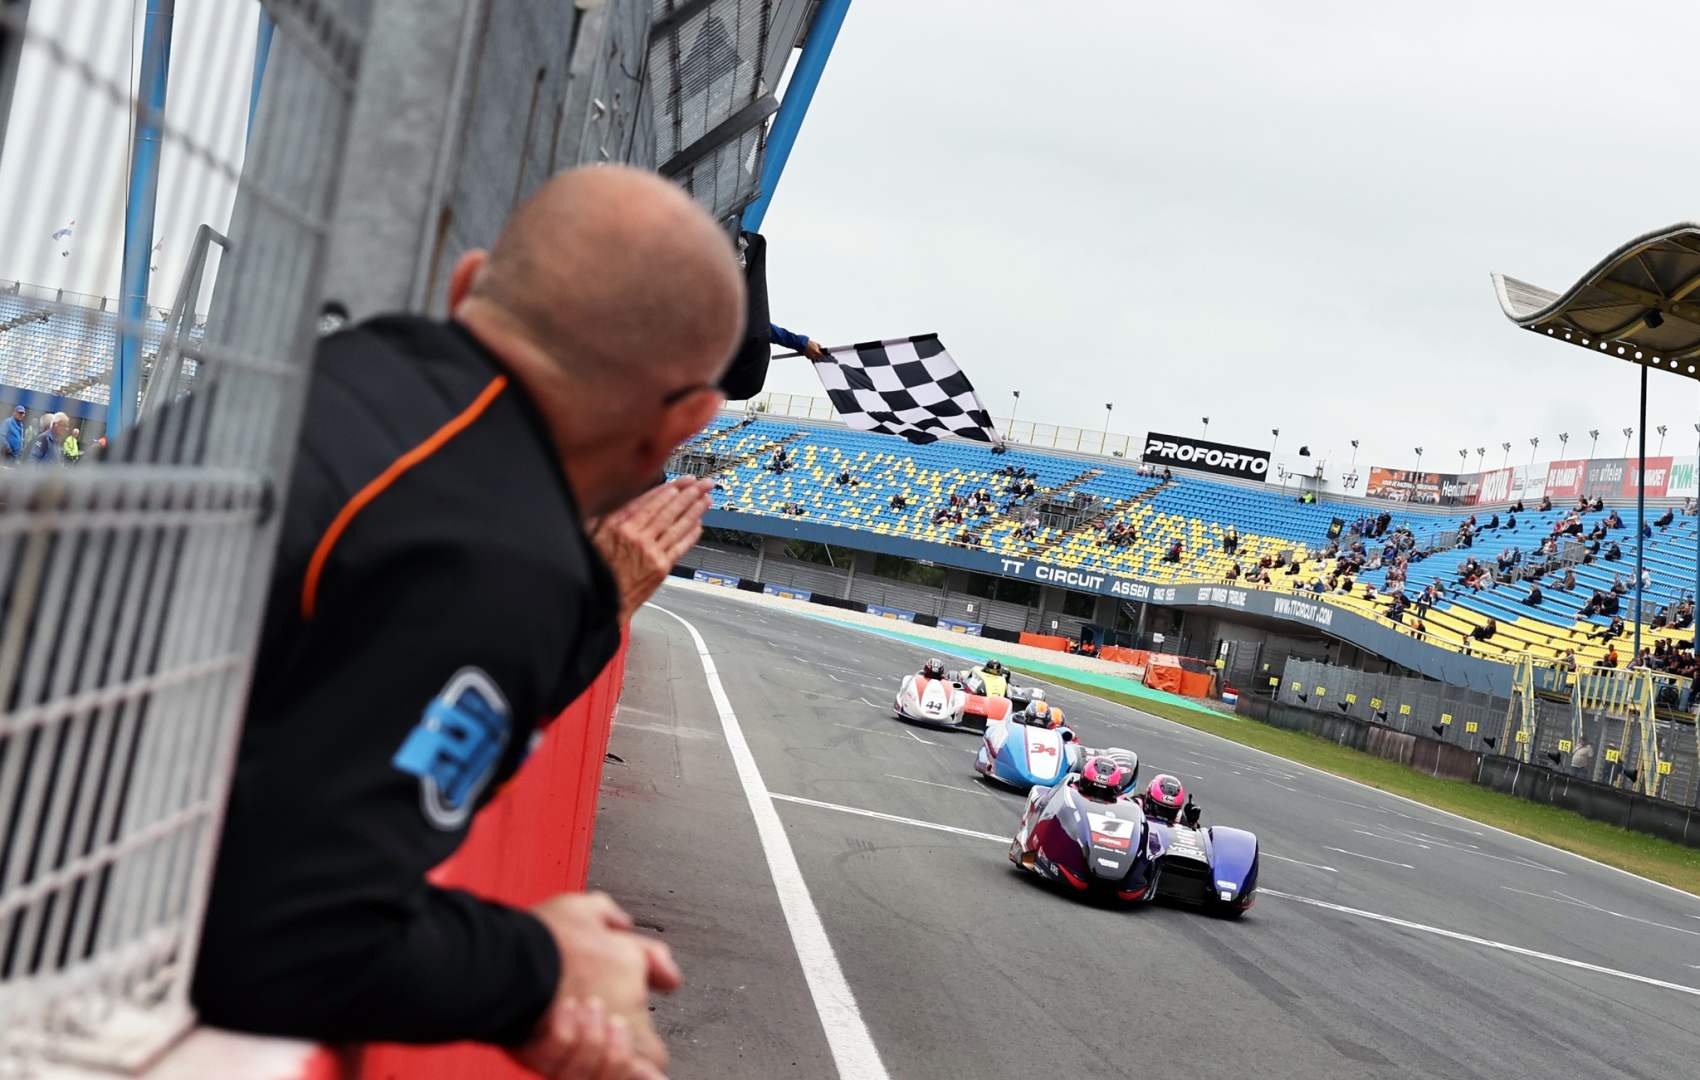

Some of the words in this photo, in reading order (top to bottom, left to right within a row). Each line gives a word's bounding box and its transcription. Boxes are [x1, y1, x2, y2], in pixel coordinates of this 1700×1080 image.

[1145, 439, 1268, 474] PROFORTO
[1670, 464, 1693, 489] TVM
[1001, 559, 1024, 574] TT
[1035, 566, 1104, 589] CIRCUIT
[1111, 580, 1149, 599] ASSEN
[925, 701, 943, 711] 44
[1031, 742, 1057, 757] 34
